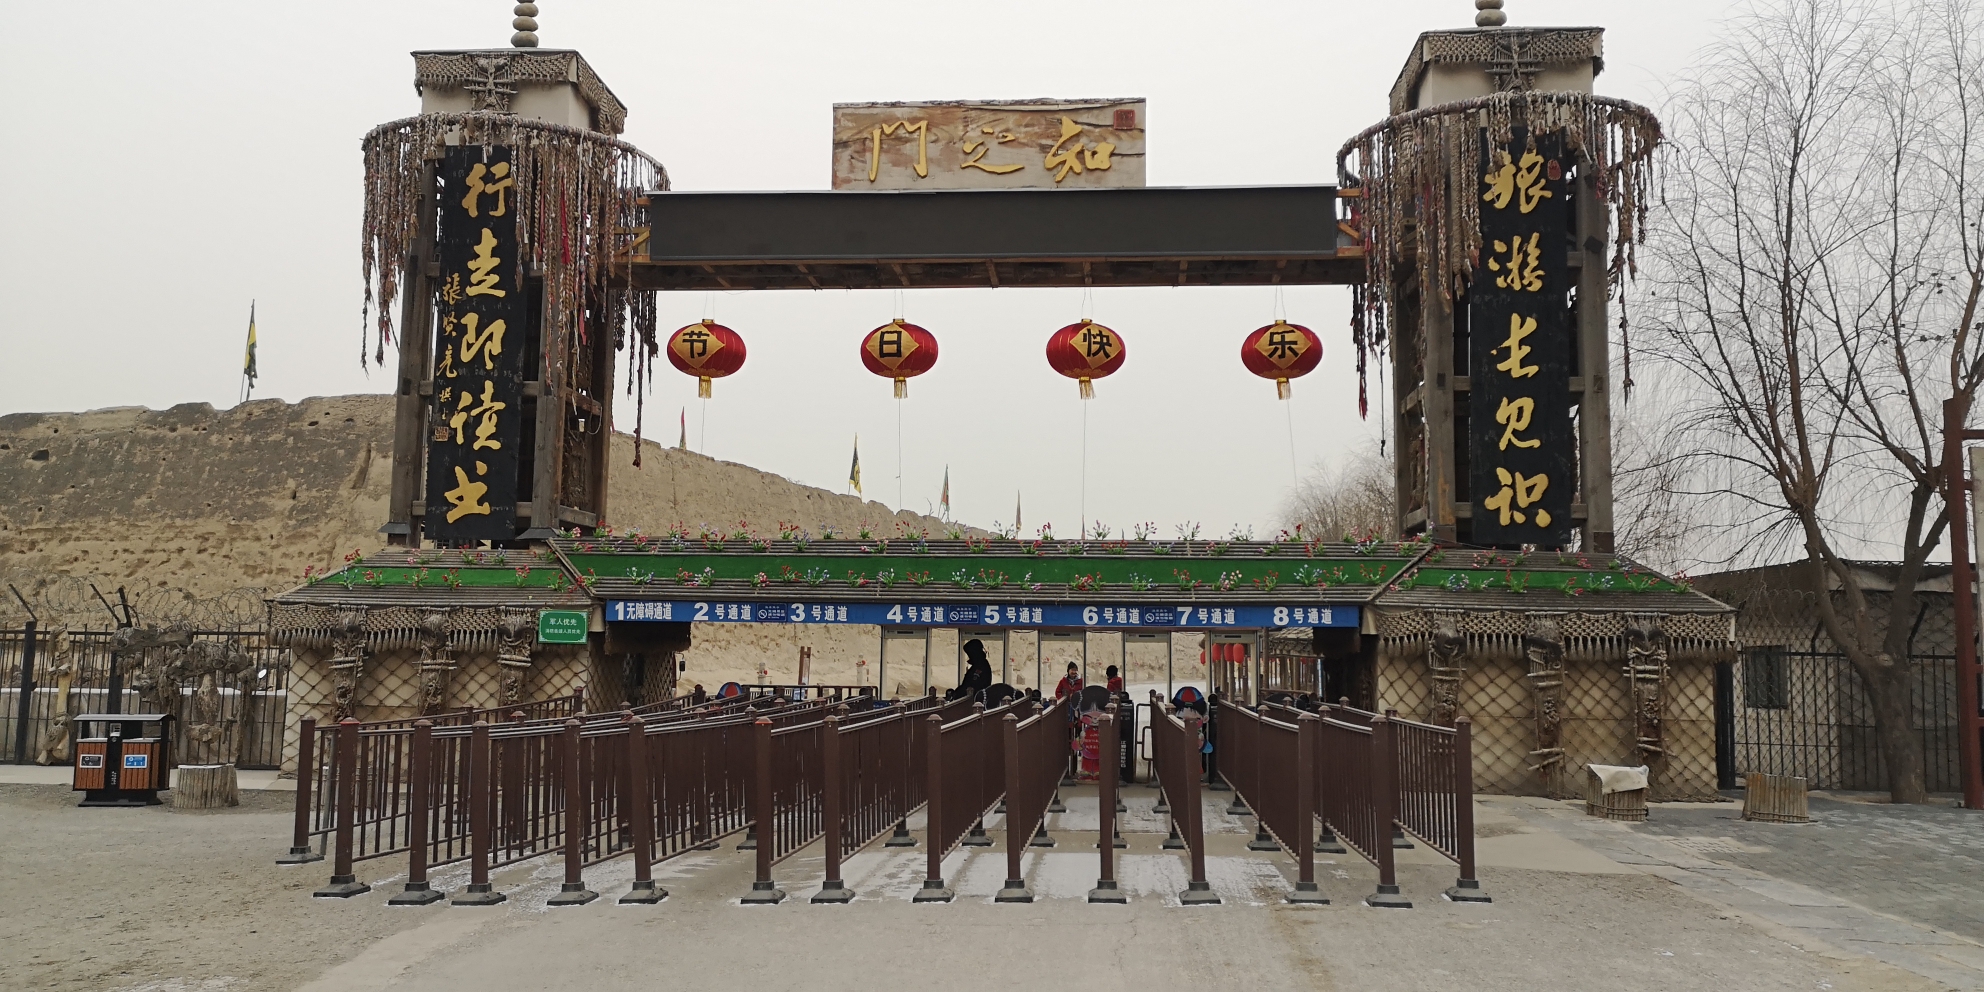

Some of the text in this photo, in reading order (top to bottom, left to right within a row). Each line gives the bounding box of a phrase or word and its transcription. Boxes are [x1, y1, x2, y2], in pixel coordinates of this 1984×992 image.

[682, 329, 1301, 360] 节 日 快 乐
[549, 618, 577, 626] 军人优先
